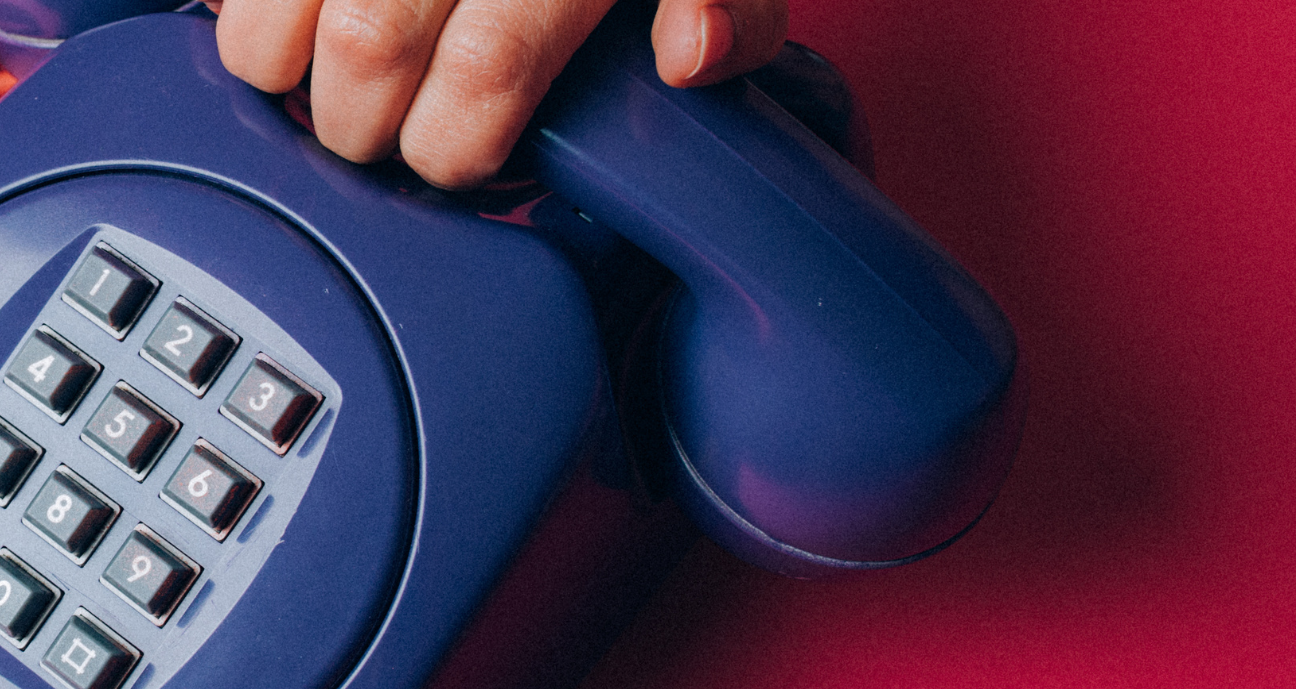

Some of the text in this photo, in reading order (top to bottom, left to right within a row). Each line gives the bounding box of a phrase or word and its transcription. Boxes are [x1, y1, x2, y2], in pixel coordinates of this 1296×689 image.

[89, 268, 276, 411] 1 2 3
[27, 354, 213, 498] 4 5 6
[46, 494, 73, 524] 8
[126, 555, 152, 583] 9
